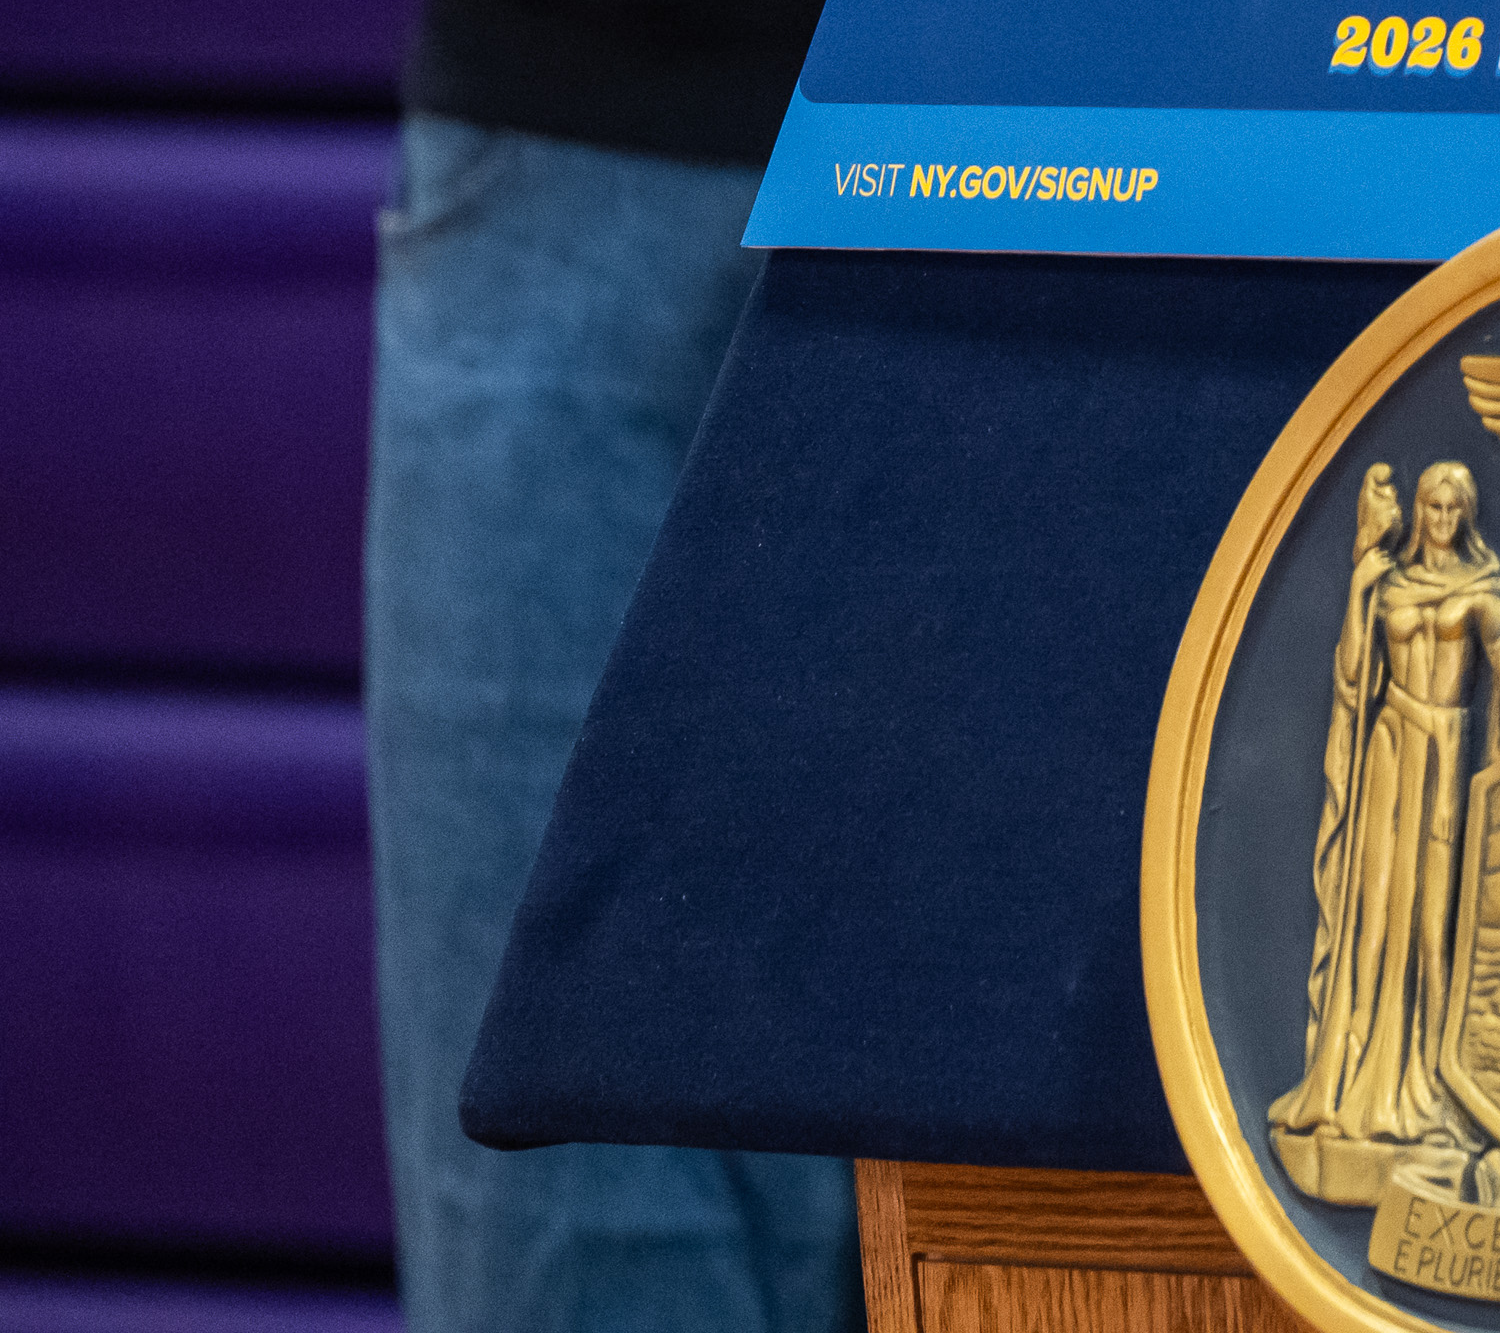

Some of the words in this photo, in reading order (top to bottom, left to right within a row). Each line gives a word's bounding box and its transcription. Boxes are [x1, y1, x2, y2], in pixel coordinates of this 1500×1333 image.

[1331, 15, 1485, 71] 2026
[835, 163, 905, 197] VISIT
[909, 164, 1159, 201] NY.GOV/SIGNUP
[1394, 1239, 1412, 1273] E
